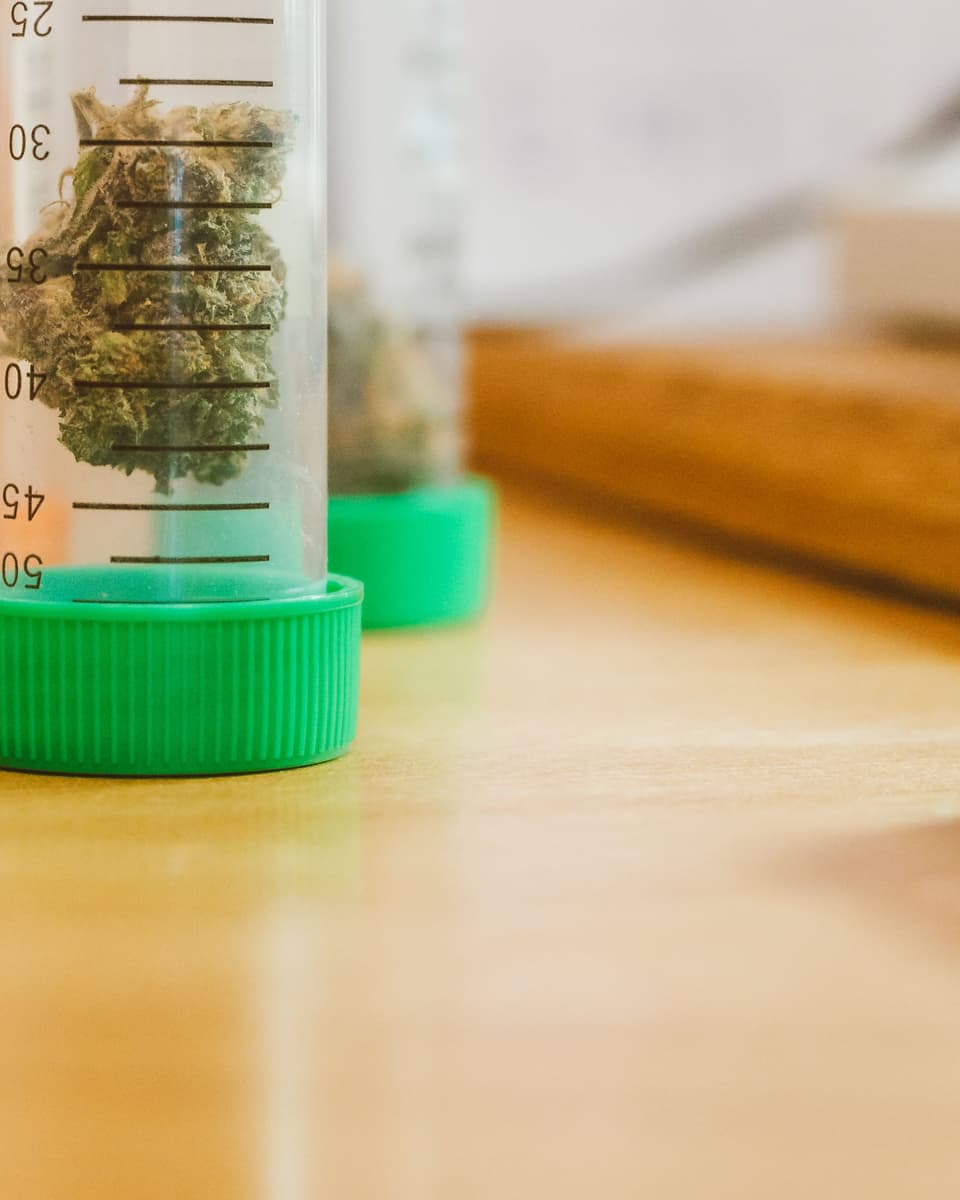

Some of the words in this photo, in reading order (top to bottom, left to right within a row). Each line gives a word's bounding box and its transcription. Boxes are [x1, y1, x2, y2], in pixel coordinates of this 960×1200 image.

[11, 1, 54, 37] 25
[9, 124, 50, 161] 30
[6, 247, 48, 285] 35
[4, 363, 47, 401] 40
[2, 483, 45, 521] 45
